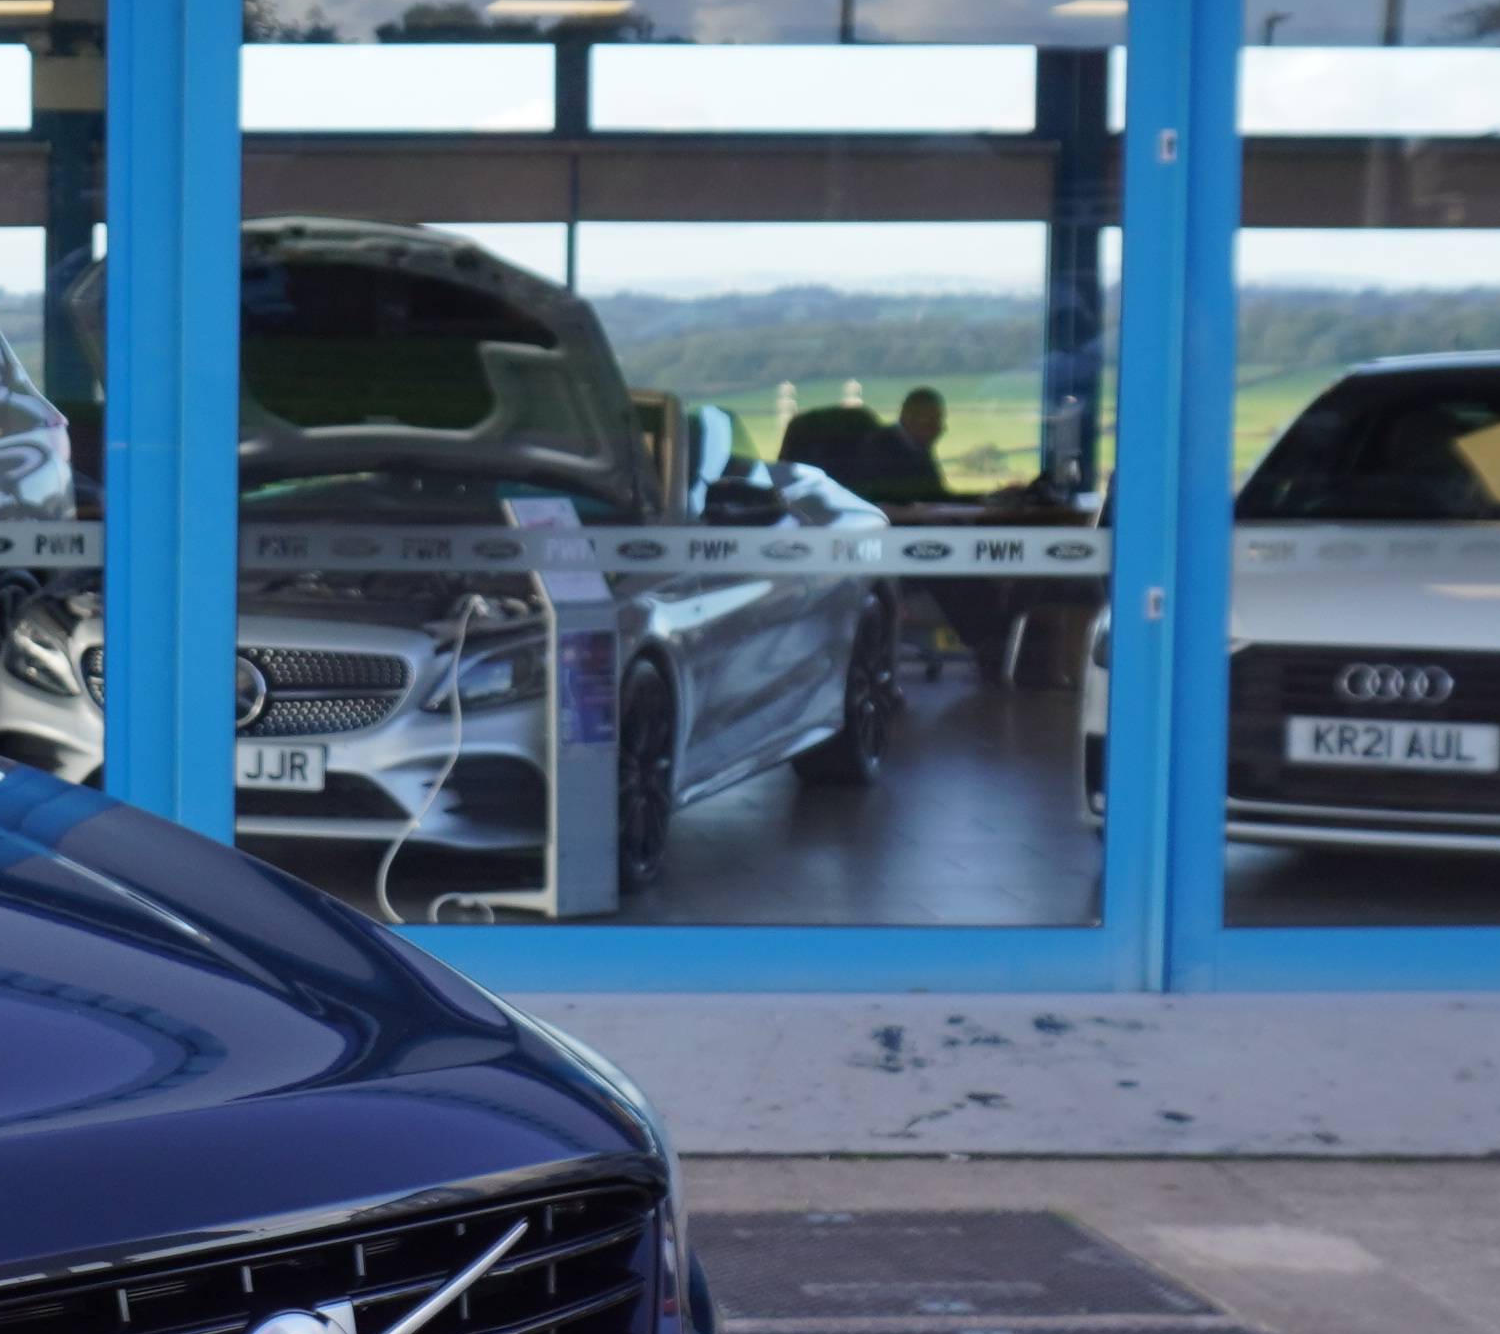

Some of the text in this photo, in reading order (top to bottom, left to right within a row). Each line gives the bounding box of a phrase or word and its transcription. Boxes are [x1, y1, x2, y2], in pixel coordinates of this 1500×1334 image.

[35, 533, 85, 555] PWM
[975, 539, 1025, 562] PWM
[1312, 724, 1477, 763] KR21 AUL
[244, 748, 309, 783] JJR
